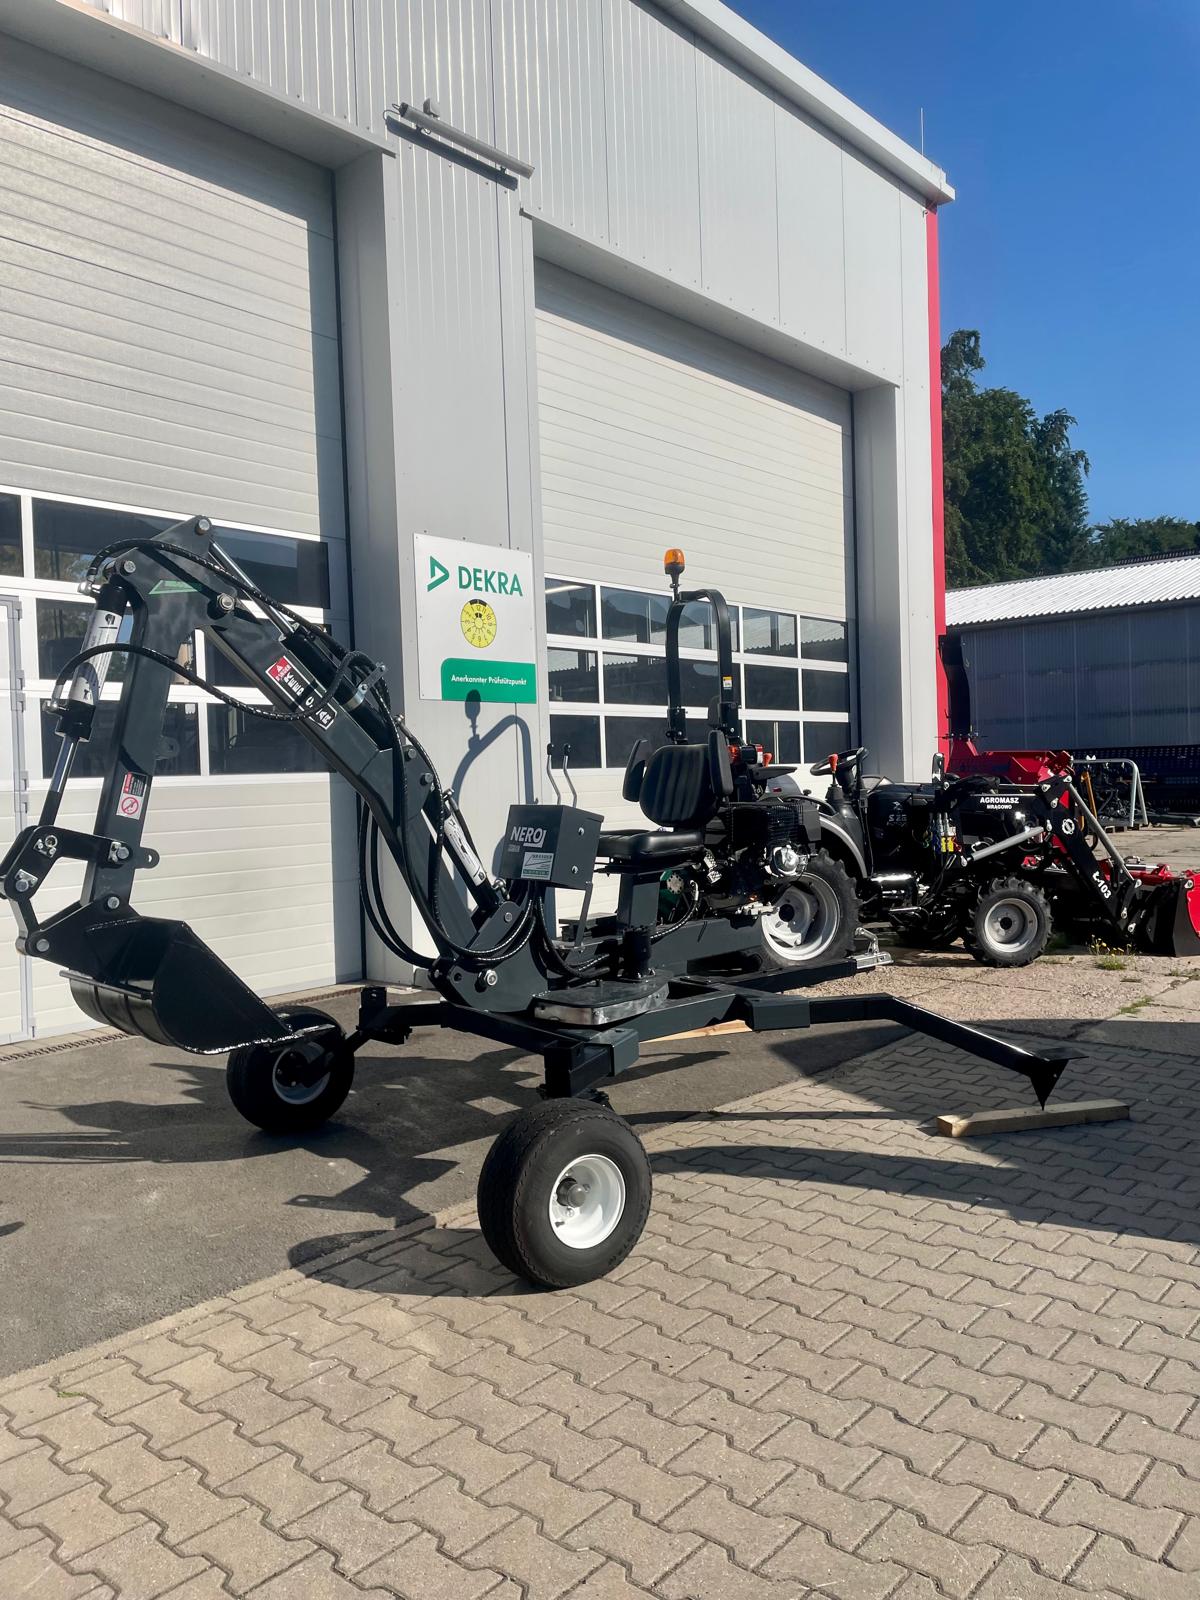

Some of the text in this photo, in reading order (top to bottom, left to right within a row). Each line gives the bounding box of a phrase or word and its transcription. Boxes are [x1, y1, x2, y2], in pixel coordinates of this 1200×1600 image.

[458, 566, 523, 597] DEKRA
[283, 671, 305, 697] KEEP
[451, 674, 527, 686] Anerkannter Prüfstützpunkt
[979, 796, 1020, 804] AGROMASZ
